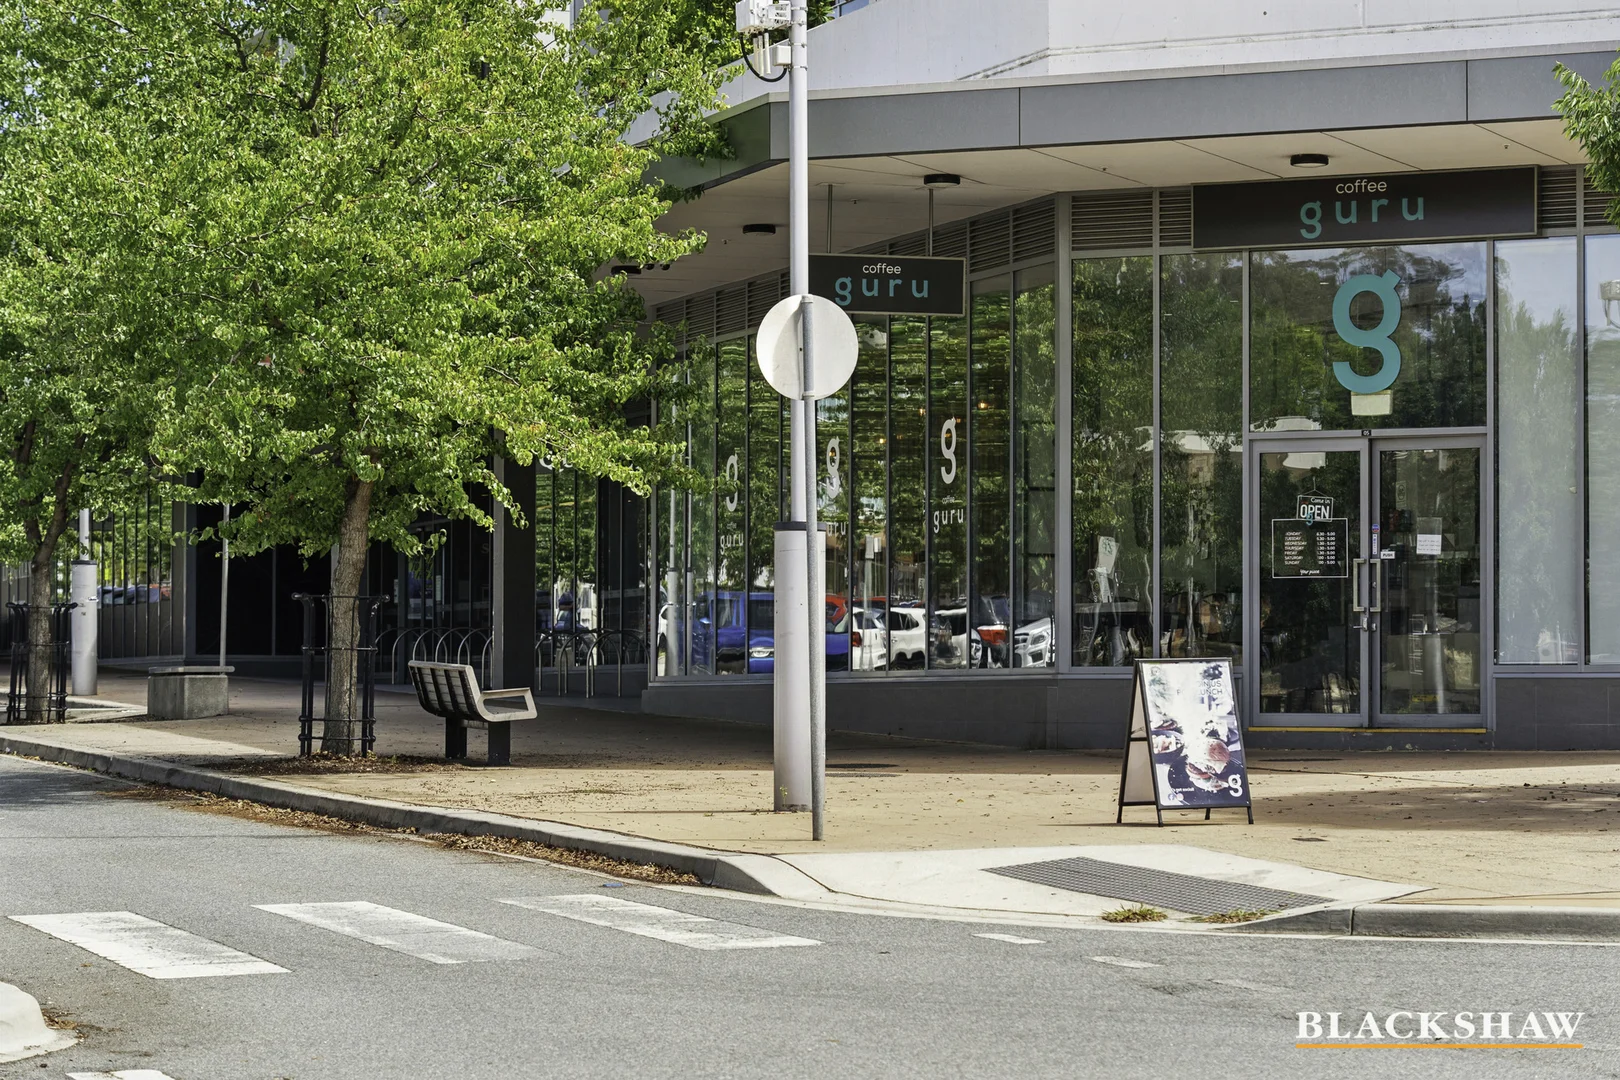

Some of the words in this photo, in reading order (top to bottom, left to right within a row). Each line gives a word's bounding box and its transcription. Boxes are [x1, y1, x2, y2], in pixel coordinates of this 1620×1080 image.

[1335, 179, 1387, 194] coffee
[1300, 197, 1425, 239] guru
[862, 263, 901, 274] coffee
[835, 276, 929, 306] guru
[1332, 268, 1402, 394] g
[941, 417, 957, 485] g
[826, 436, 841, 499] g
[933, 509, 964, 533] guru
[1300, 504, 1330, 519] OPEN
[826, 522, 847, 537] uru
[720, 533, 744, 555] guru
